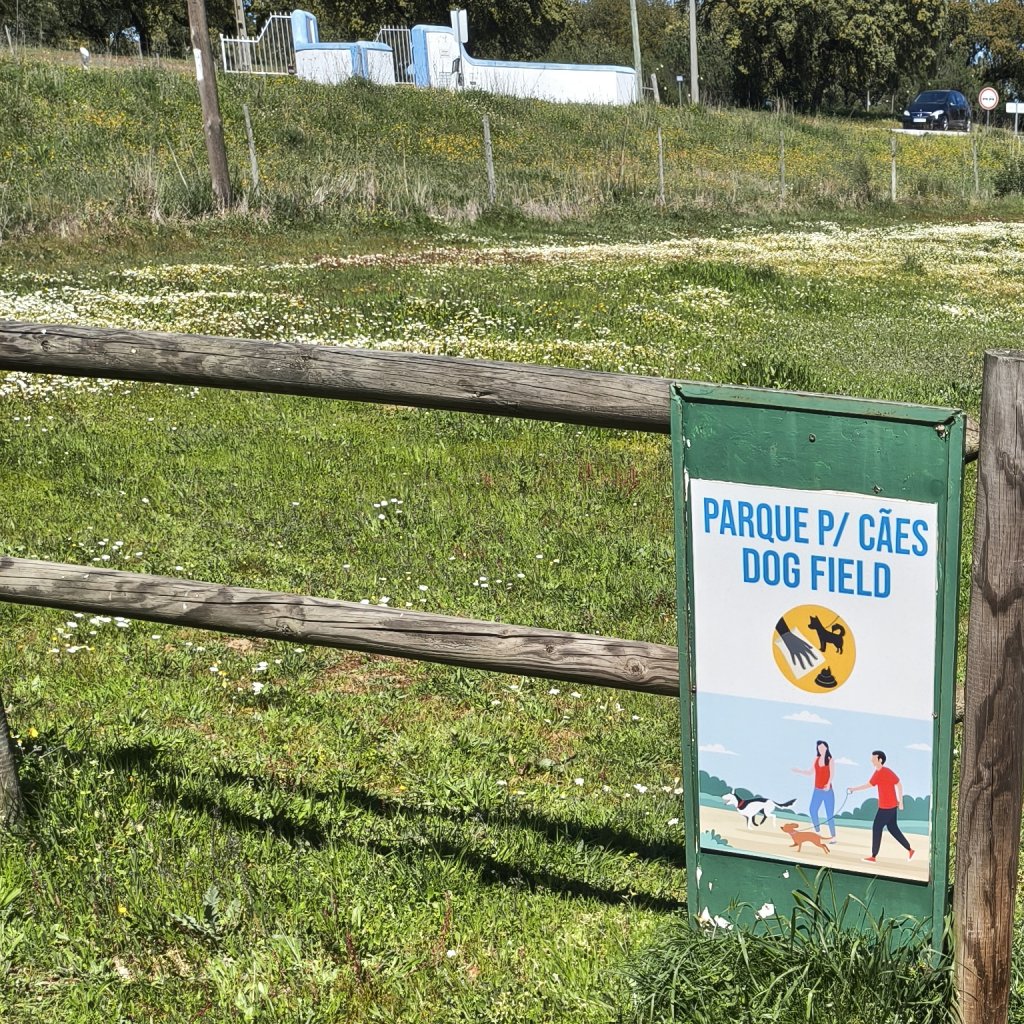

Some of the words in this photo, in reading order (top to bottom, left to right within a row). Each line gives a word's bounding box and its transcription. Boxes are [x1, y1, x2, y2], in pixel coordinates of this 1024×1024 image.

[703, 497, 809, 543] PARQUE
[818, 509, 850, 547] P/
[859, 508, 929, 556] CÃES
[742, 548, 800, 588] DOG
[811, 555, 891, 598] FIELD
